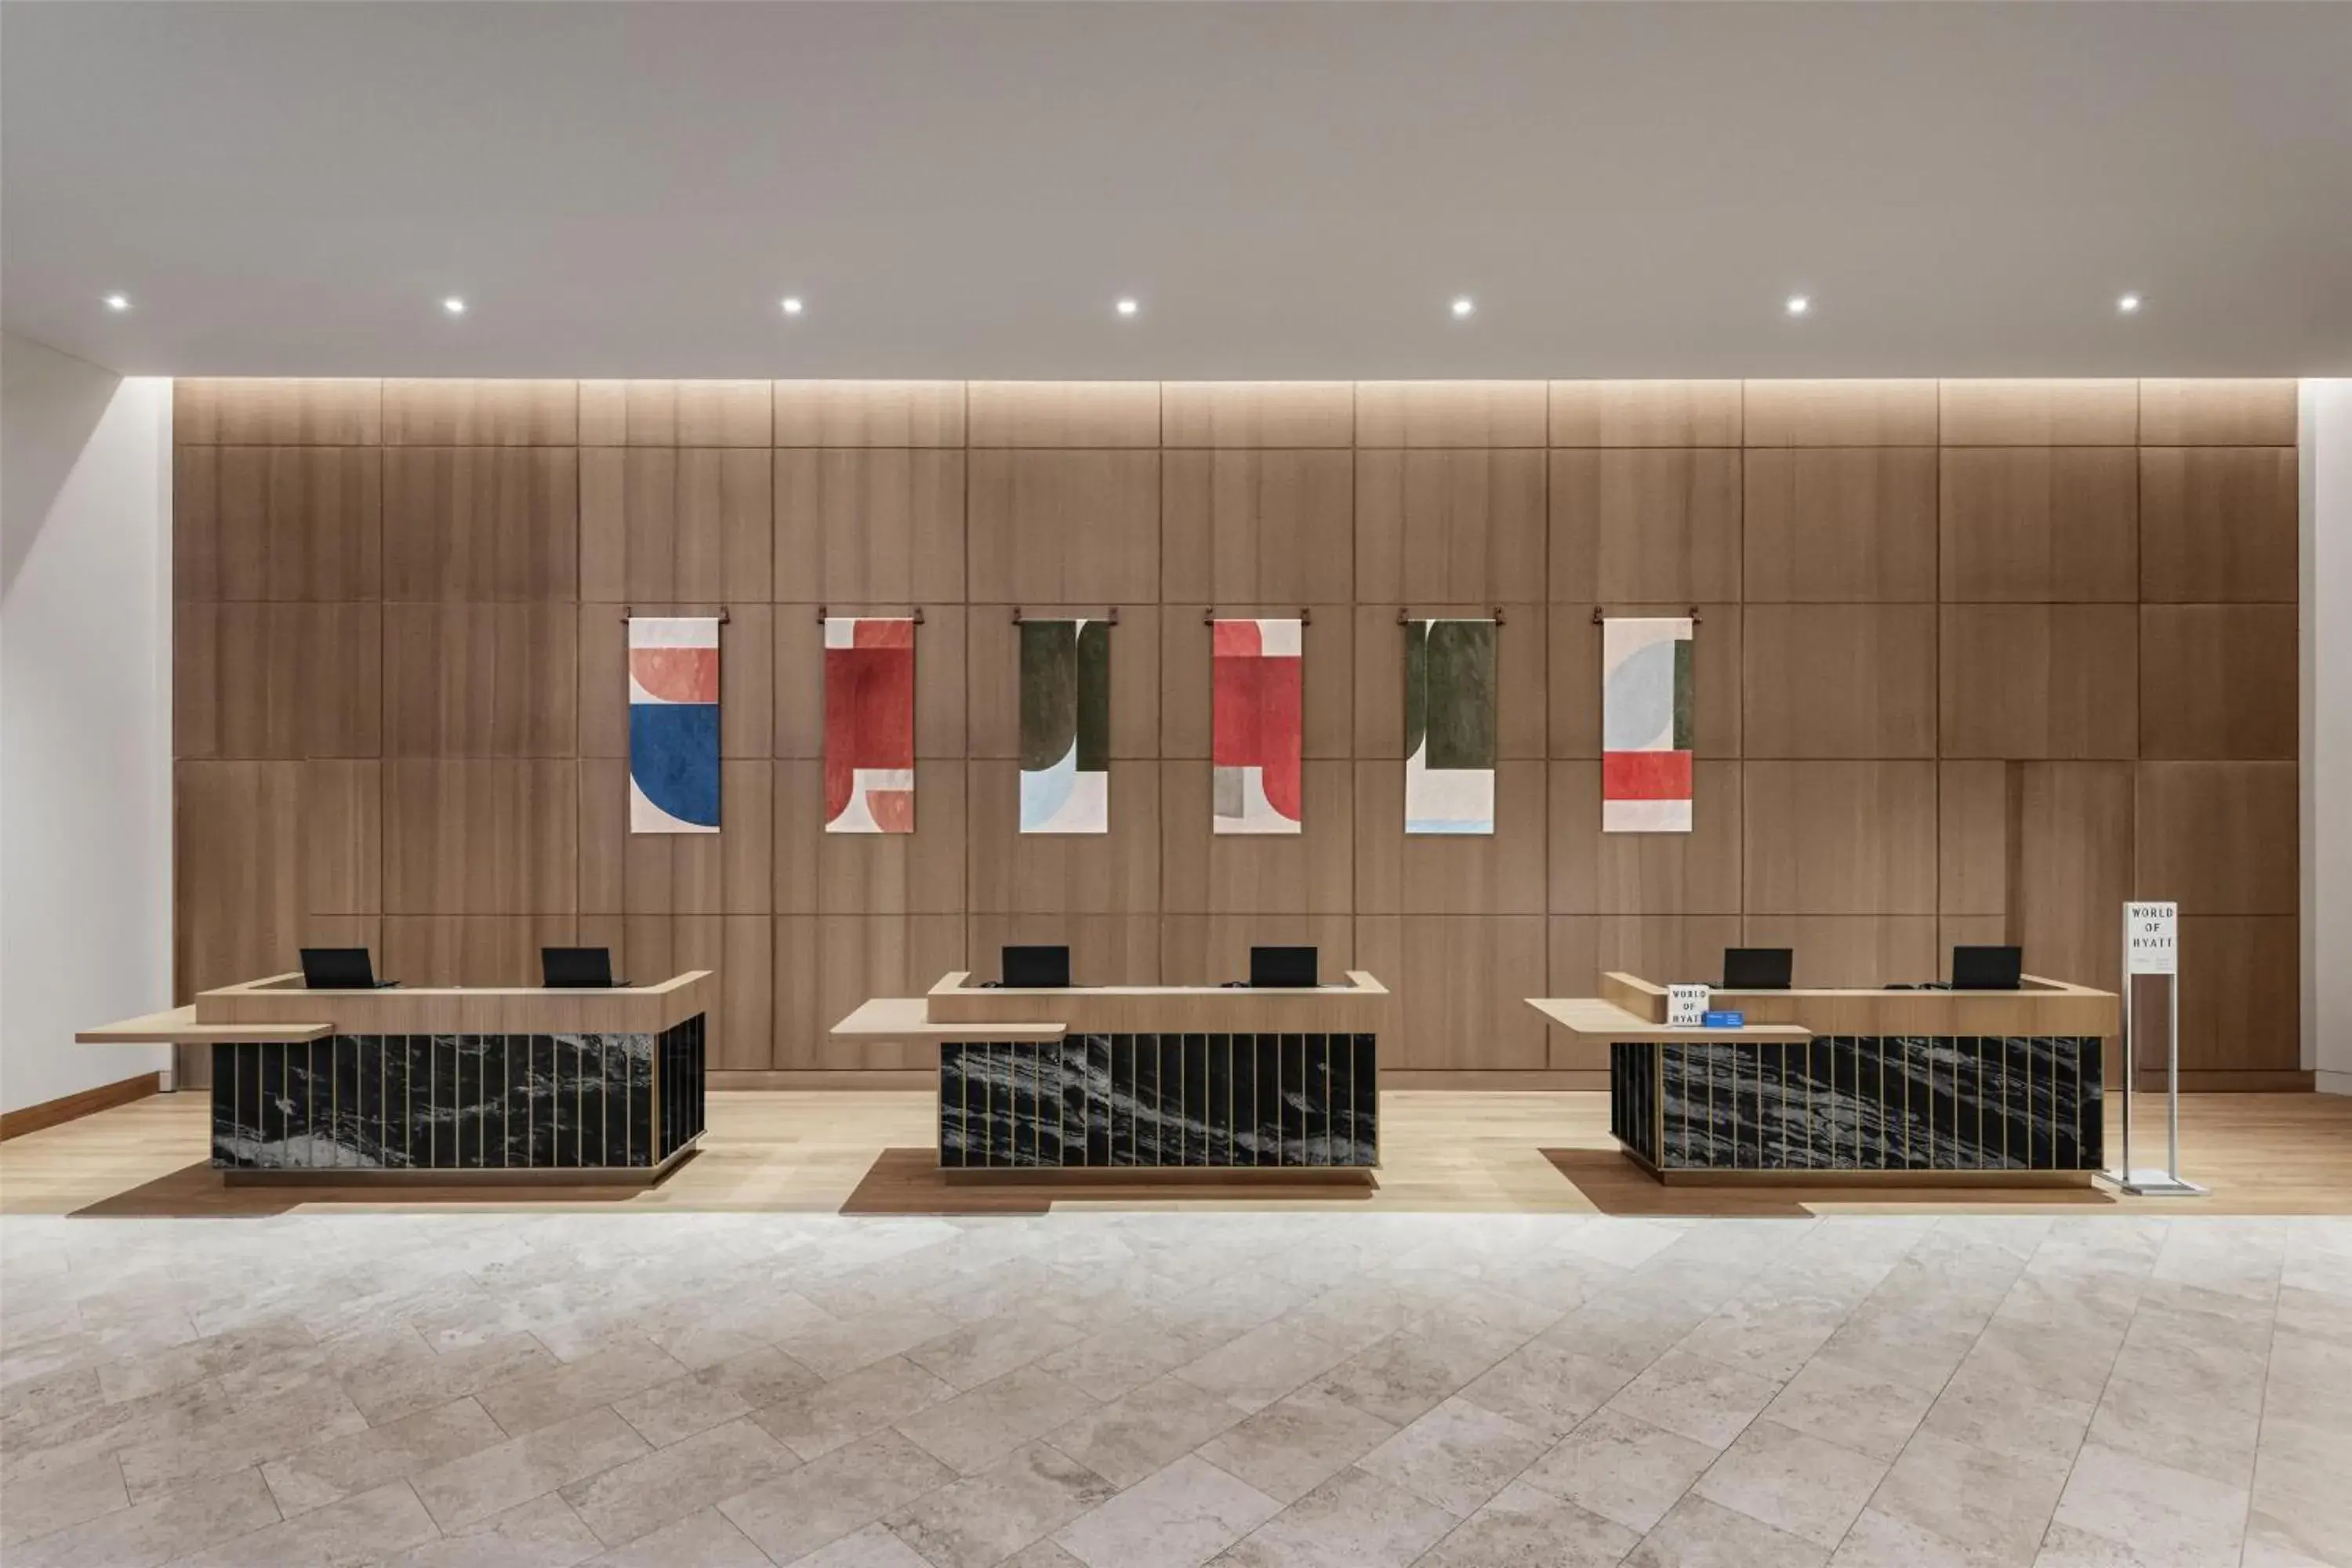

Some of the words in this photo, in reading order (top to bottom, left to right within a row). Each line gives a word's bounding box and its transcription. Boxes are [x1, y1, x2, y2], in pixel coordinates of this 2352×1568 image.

[2132, 908, 2173, 917] WORLD
[2145, 923, 2161, 932] OF
[2133, 938, 2172, 948] HYATT
